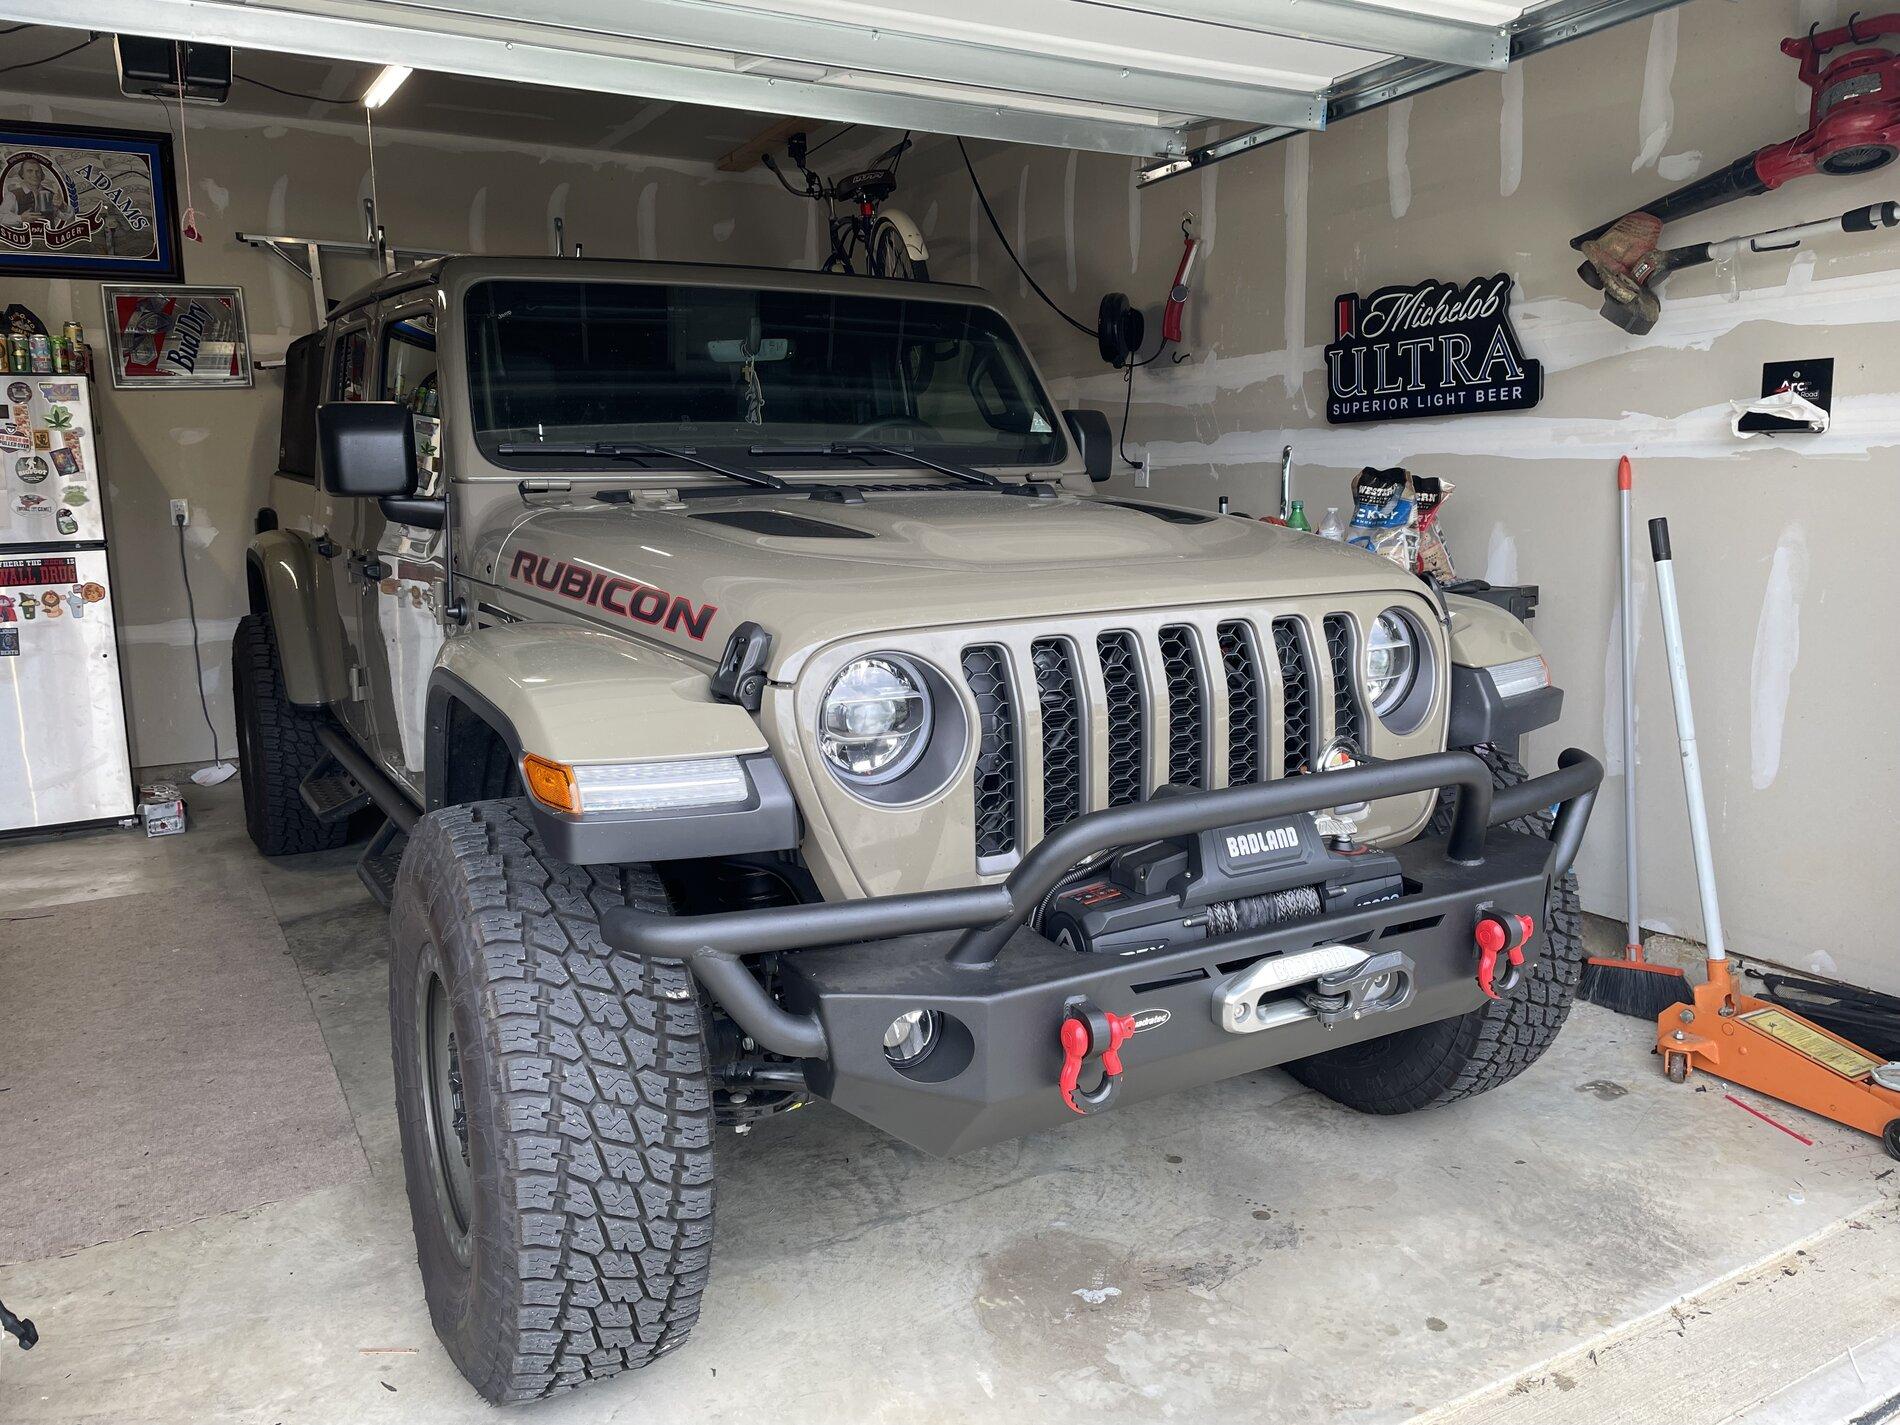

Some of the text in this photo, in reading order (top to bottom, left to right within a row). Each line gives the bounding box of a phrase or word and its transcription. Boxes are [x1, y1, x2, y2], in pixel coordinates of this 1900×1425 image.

[74, 163, 150, 231] ADAMS
[55, 227, 82, 244] LAGER
[1362, 281, 1504, 338] Michelob
[1329, 324, 1525, 398] ULTRA
[1333, 386, 1523, 415] SUPERIOR LIGHT BEER
[0, 564, 76, 585] WALL DRUG
[509, 550, 718, 642] RUBICON
[1225, 826, 1299, 858] BADLAND
